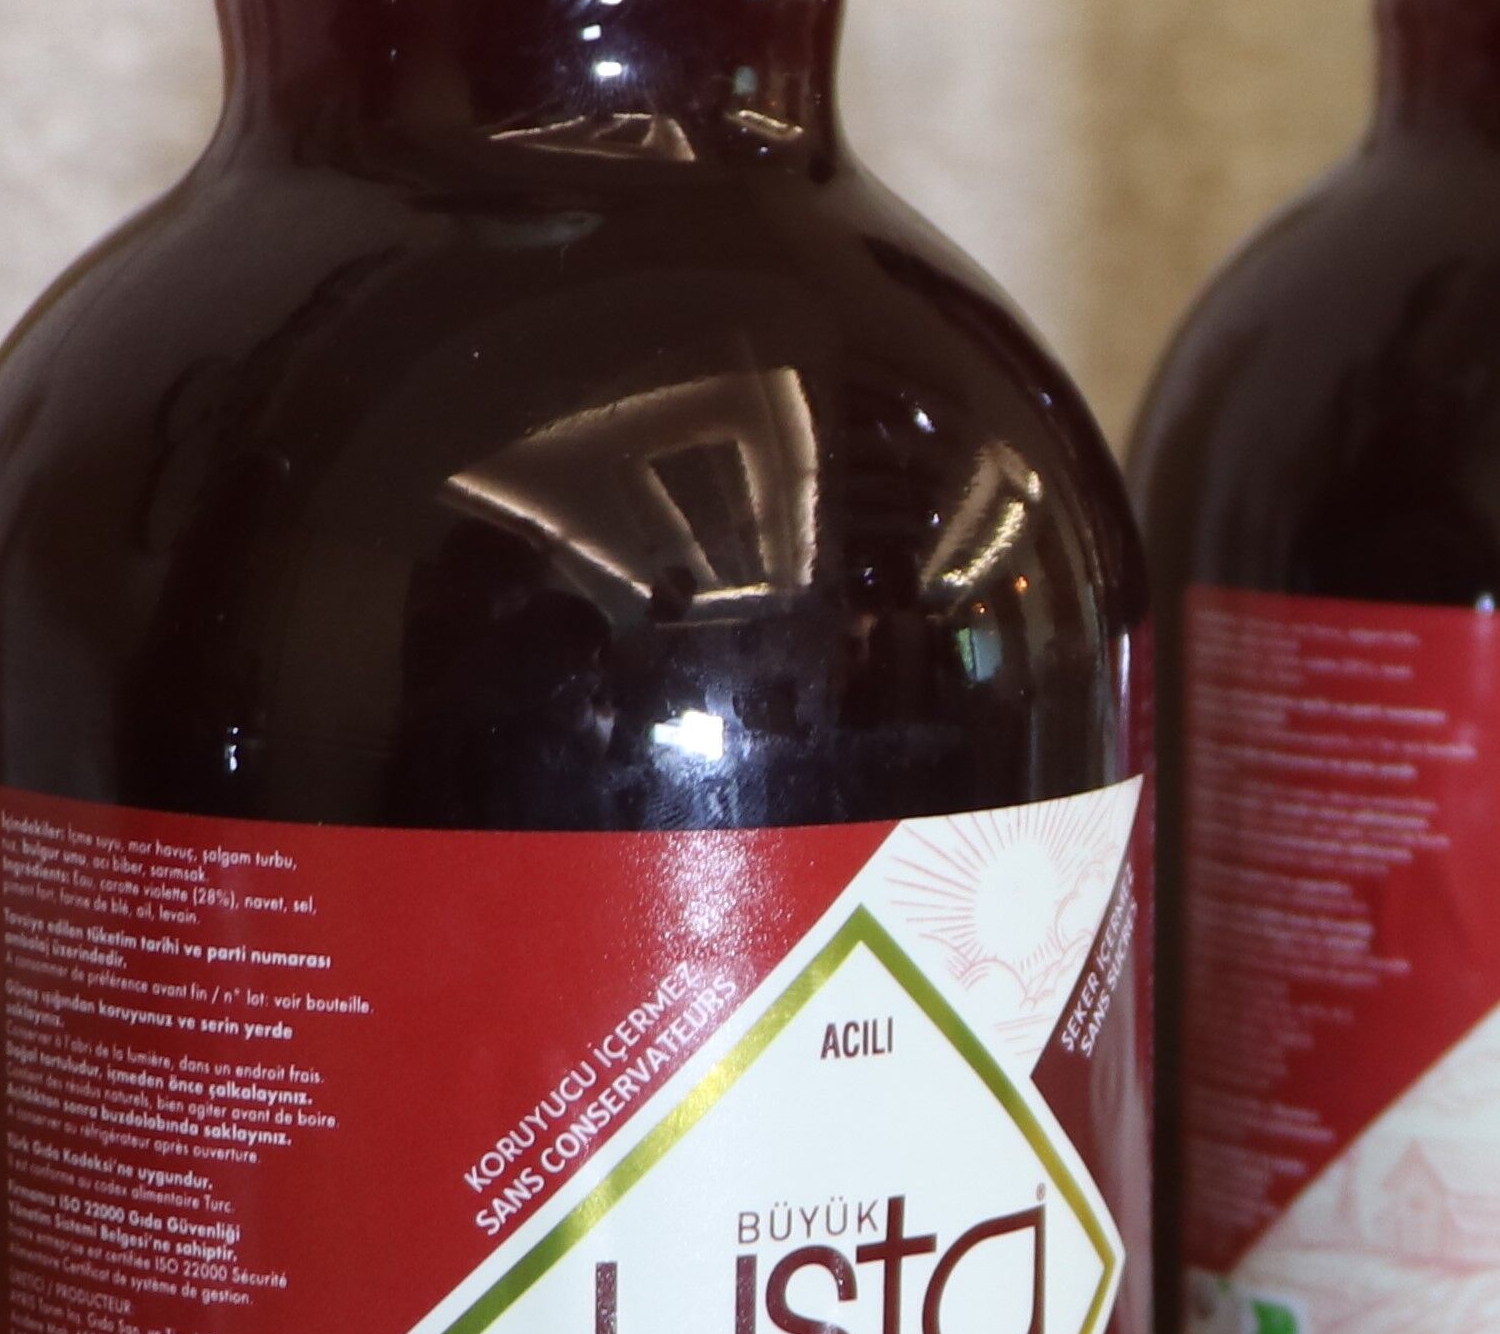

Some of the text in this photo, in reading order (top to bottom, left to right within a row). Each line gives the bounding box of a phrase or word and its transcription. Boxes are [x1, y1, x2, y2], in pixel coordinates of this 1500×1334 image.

[255, 850, 298, 871] turbu,
[244, 896, 288, 914] navet,
[292, 895, 317, 915] sel,
[140, 934, 180, 955] tarihi
[183, 942, 202, 958] ve
[207, 945, 246, 963] parti
[250, 950, 331, 969] numarası
[152, 982, 188, 998] avant
[191, 982, 208, 1002] fin
[211, 985, 220, 1004] /
[274, 993, 301, 1010] voir
[306, 992, 374, 1014] bouteille.
[98, 998, 294, 1040] koruyunuz ve serin yerde
[1081, 989, 1111, 1057] SANS
[820, 1016, 895, 1060] ACILI
[168, 1075, 204, 1094] önce
[179, 1054, 211, 1075] dans
[214, 1063, 231, 1076] un
[235, 1062, 285, 1081] endroit
[463, 959, 706, 1194] KORUYUCU İÇERMEZ
[188, 1101, 228, 1121] agiter
[231, 1107, 270, 1123] avant
[275, 1108, 293, 1126] de
[475, 973, 738, 1236] SANS CONSERVATEURS
[128, 1208, 163, 1231] Gıda
[167, 1216, 241, 1244] Güvenliği
[737, 1196, 881, 1245] BÜYÜK
[155, 1255, 179, 1274] ISO
[183, 1263, 228, 1283] 22000
[232, 1265, 288, 1290] Sécurité
[181, 1278, 198, 1298] de
